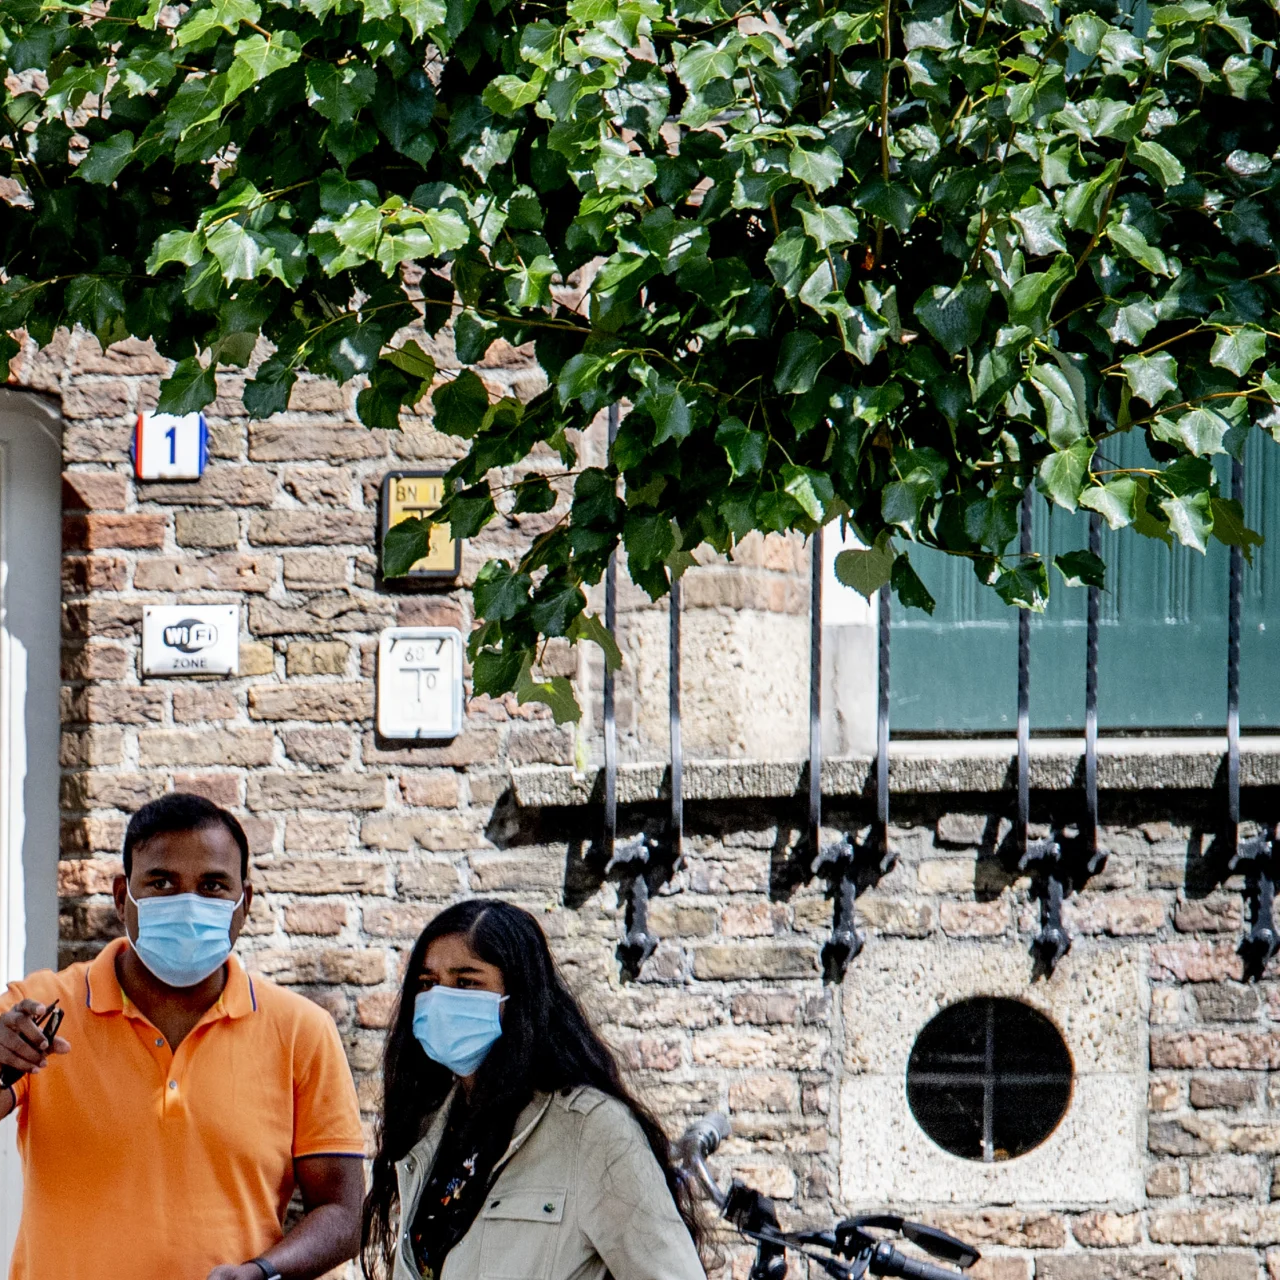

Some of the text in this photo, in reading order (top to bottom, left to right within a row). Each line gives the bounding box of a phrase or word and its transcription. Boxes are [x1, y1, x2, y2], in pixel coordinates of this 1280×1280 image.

[165, 425, 176, 465] 1
[396, 484, 417, 501] BN
[172, 658, 208, 669] ZONE
